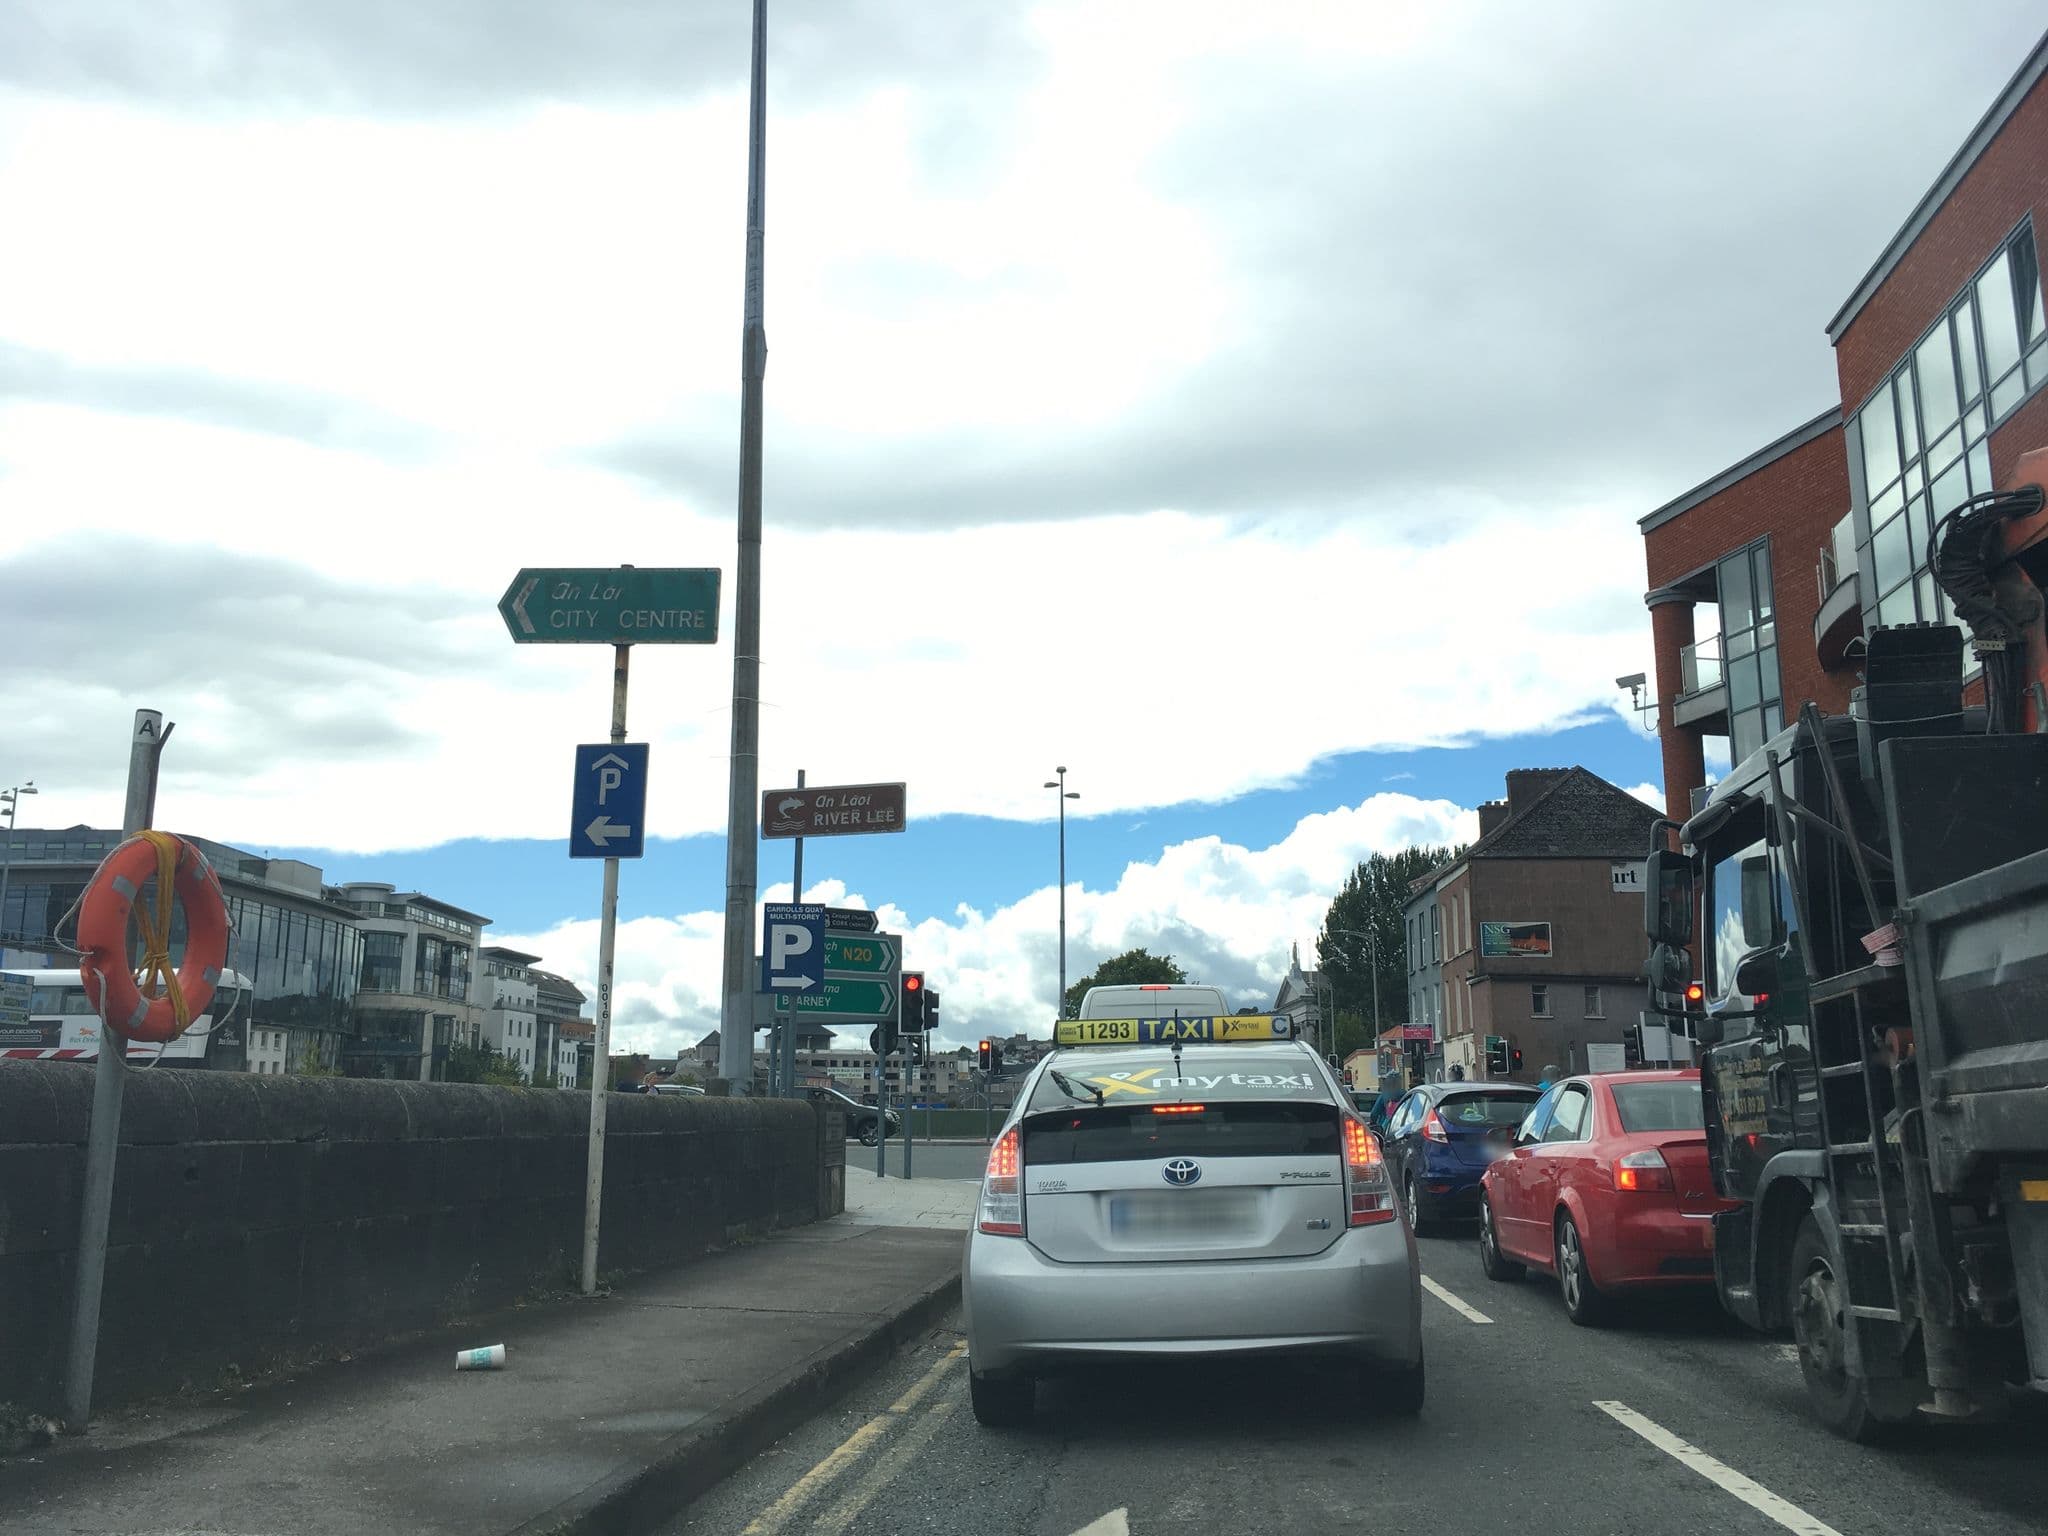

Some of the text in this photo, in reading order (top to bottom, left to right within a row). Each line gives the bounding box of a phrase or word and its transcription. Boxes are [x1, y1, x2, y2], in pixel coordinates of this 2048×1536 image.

[550, 609, 705, 628] CITY CENTRE
[138, 719, 155, 737] A
[599, 768, 621, 806] P
[814, 809, 895, 826] RIVER LEE
[1484, 924, 1512, 934] NSG
[770, 924, 813, 970] P
[843, 947, 873, 962] N20
[781, 995, 832, 1007] BARNEY
[1077, 1022, 1130, 1039] 11293
[1143, 1019, 1208, 1039] TAXI
[1152, 1073, 1315, 1089] mytaxi
